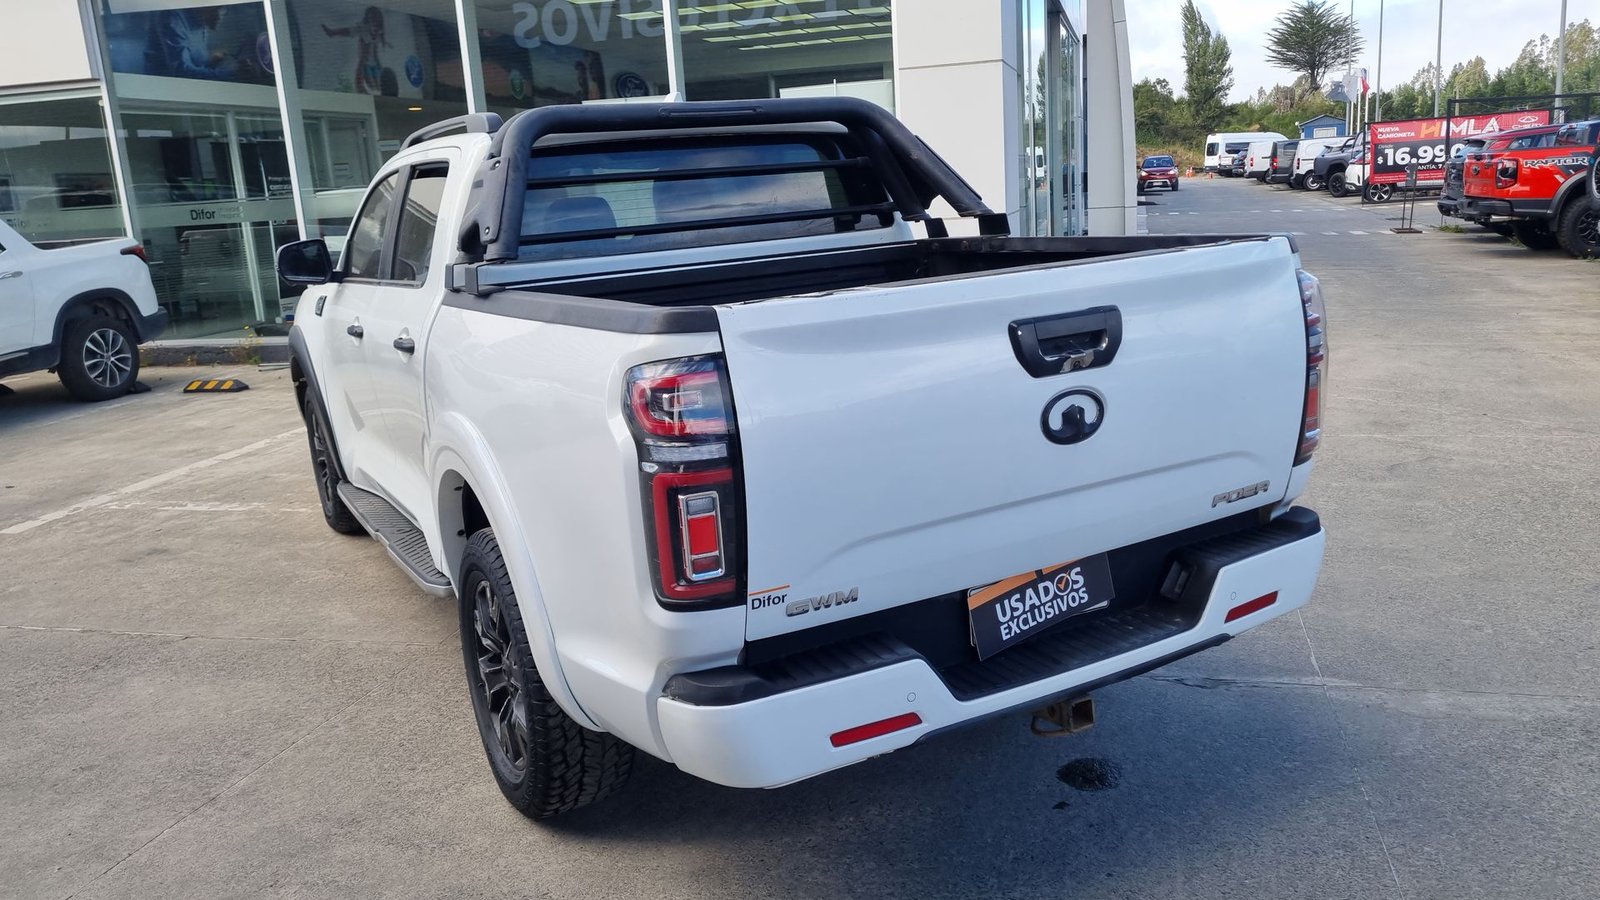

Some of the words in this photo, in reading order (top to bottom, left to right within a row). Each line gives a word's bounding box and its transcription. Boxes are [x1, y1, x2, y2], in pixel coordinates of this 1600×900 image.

[1377, 131, 1416, 139] CAMIONETA
[1420, 117, 1500, 138] HIMLA
[1523, 156, 1590, 169] RAPTOR
[190, 209, 216, 221] Difor
[751, 593, 788, 611] Difor
[785, 586, 859, 618] GWM
[995, 567, 1085, 623] USADOS
[1000, 587, 1089, 641] EXCLUSIVOS
